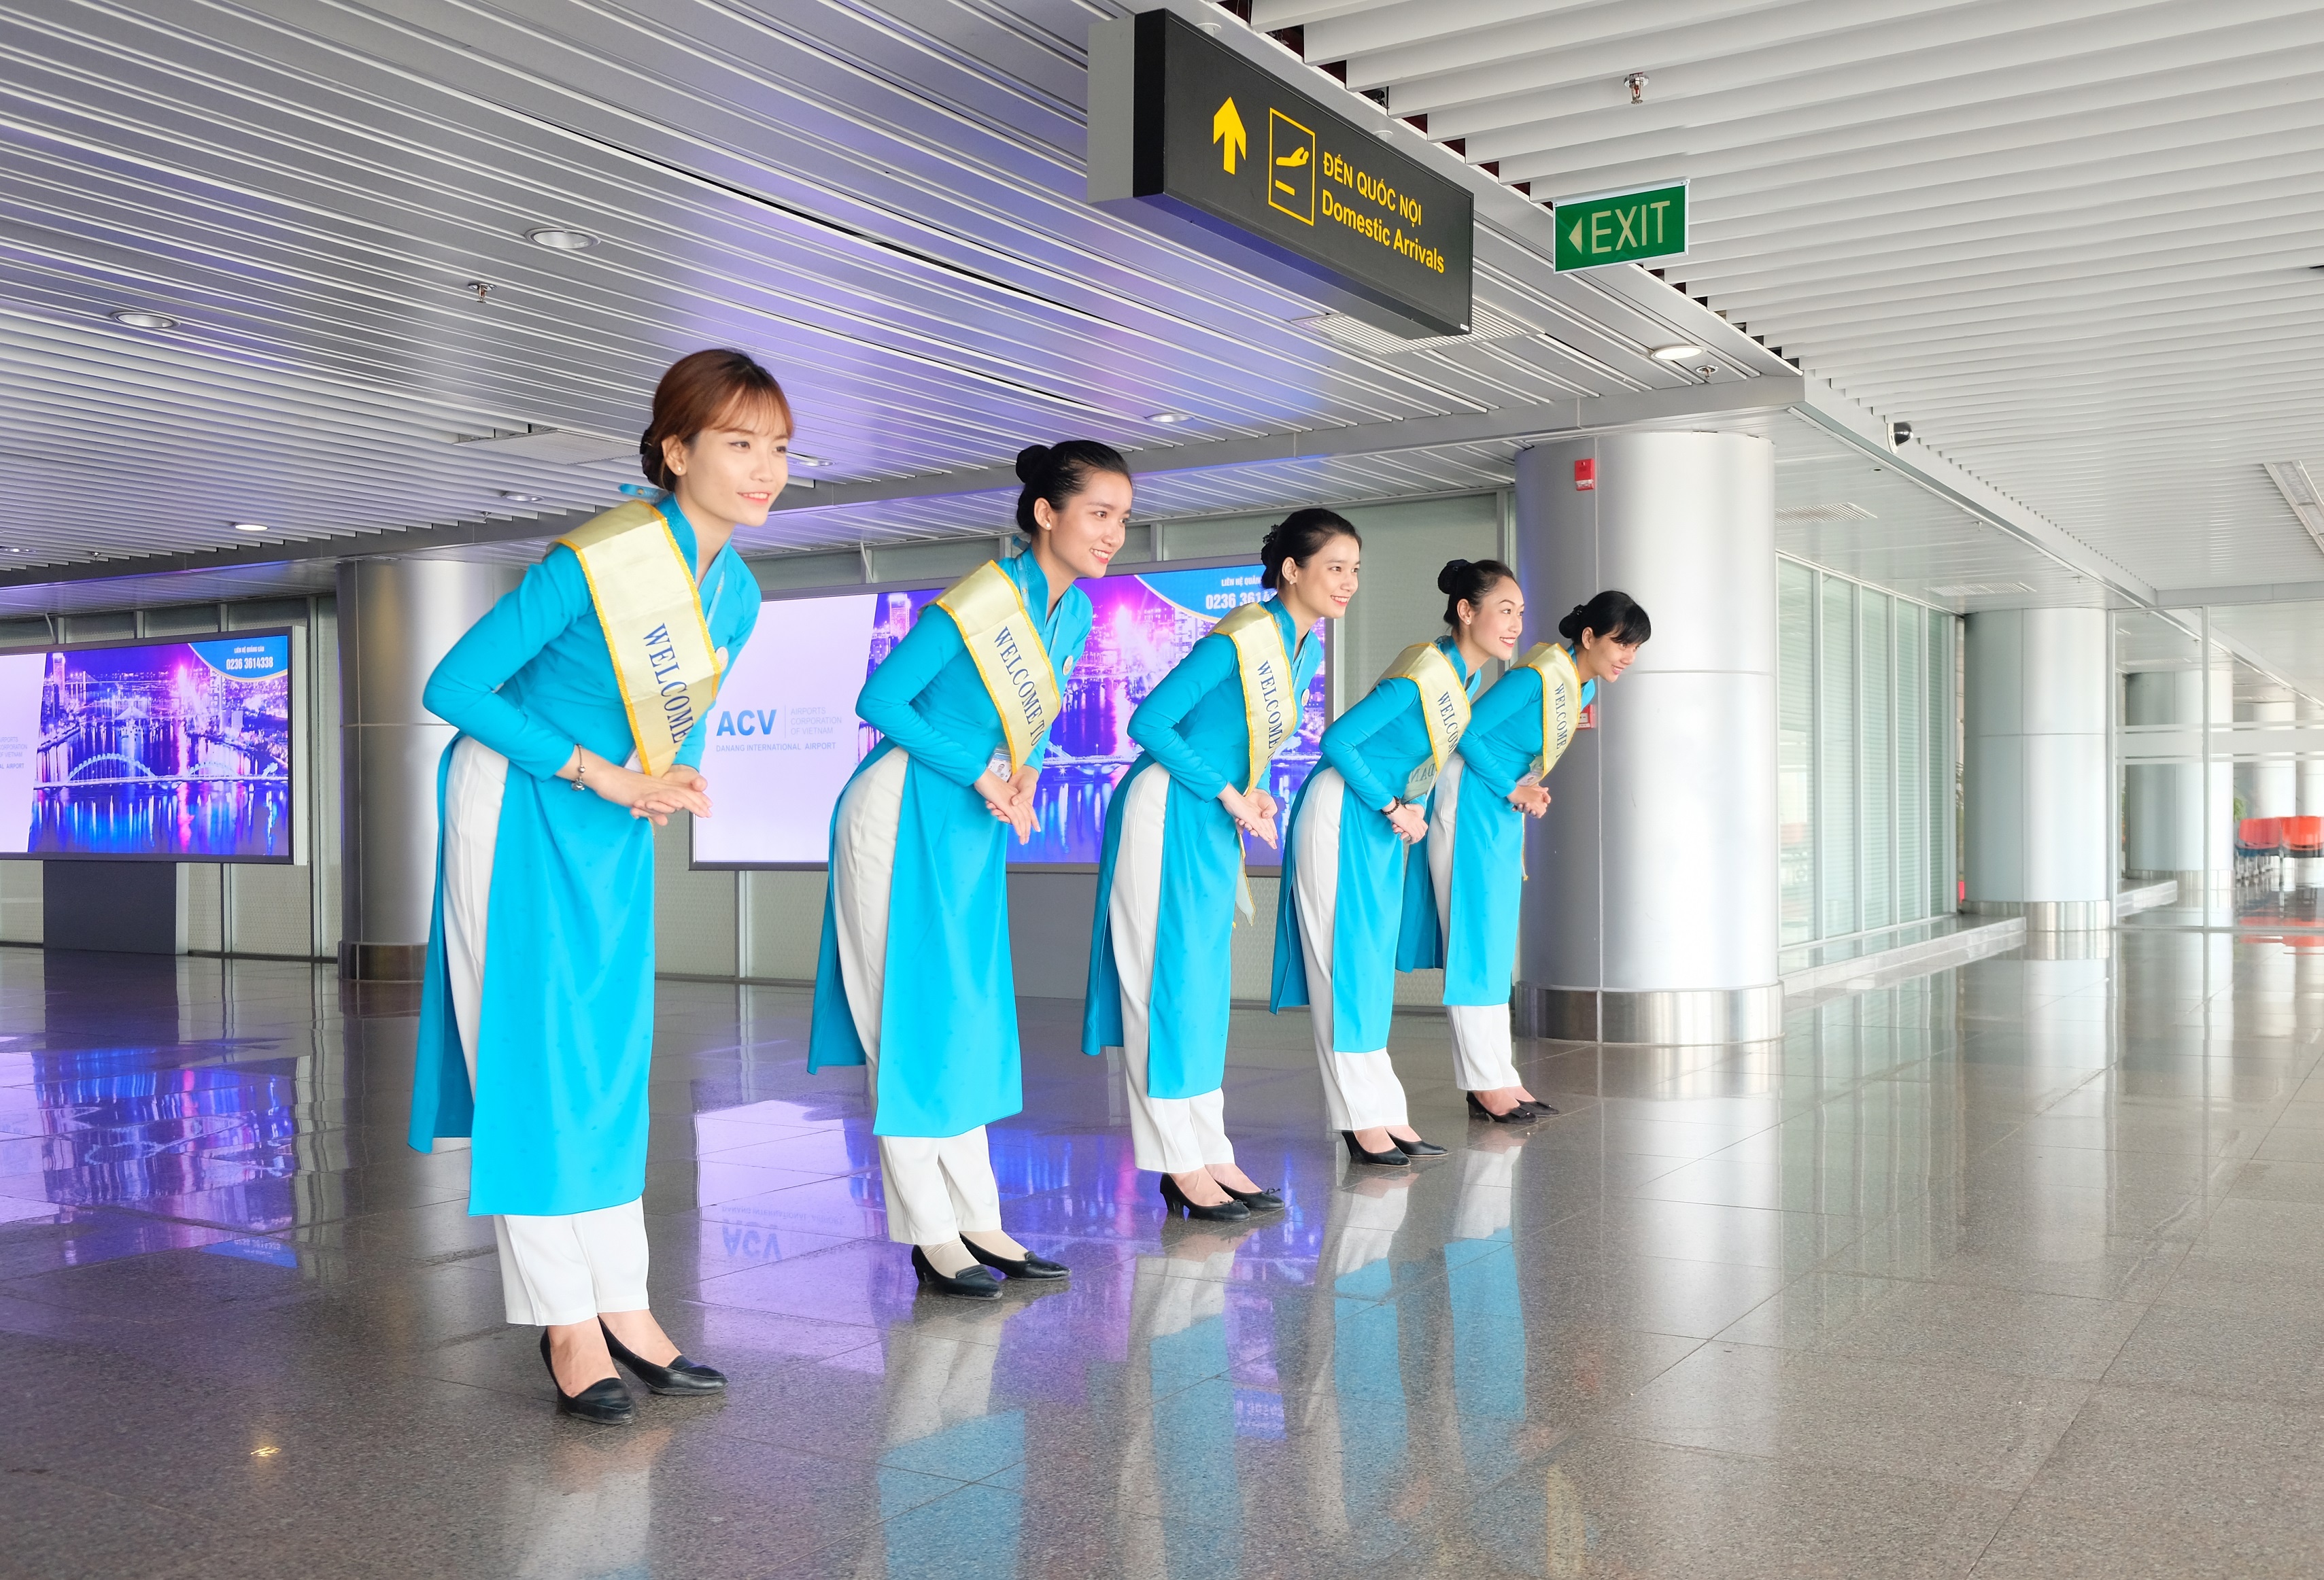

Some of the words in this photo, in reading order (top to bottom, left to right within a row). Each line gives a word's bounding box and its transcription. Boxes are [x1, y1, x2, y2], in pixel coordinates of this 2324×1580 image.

[1323, 152, 1353, 188] ĐẾN
[1357, 178, 1396, 211] QUỐC
[1399, 194, 1422, 227] NỘI
[1322, 189, 1390, 246] Domestic
[1393, 228, 1445, 273] Arrivals
[1592, 201, 1670, 254] EXIT
[1244, 575, 1263, 585] QUẢN
[1206, 593, 1236, 610] 0236
[226, 657, 243, 670] 0236
[244, 656, 273, 670] 3614338
[994, 626, 1043, 725] WELCOME
[643, 623, 694, 744] WELCOME
[716, 709, 777, 736] ACV
[791, 707, 826, 715] AIRPORTS
[791, 717, 842, 725] CORPORATION
[1257, 659, 1283, 749] WELCOME
[1437, 691, 1458, 757] WELCOM
[1554, 683, 1567, 749] WELCOME
[747, 743, 801, 751] INTERNATIONAL
[805, 742, 836, 750] AIRPORT
[802, 727, 834, 735] VIETNAM
